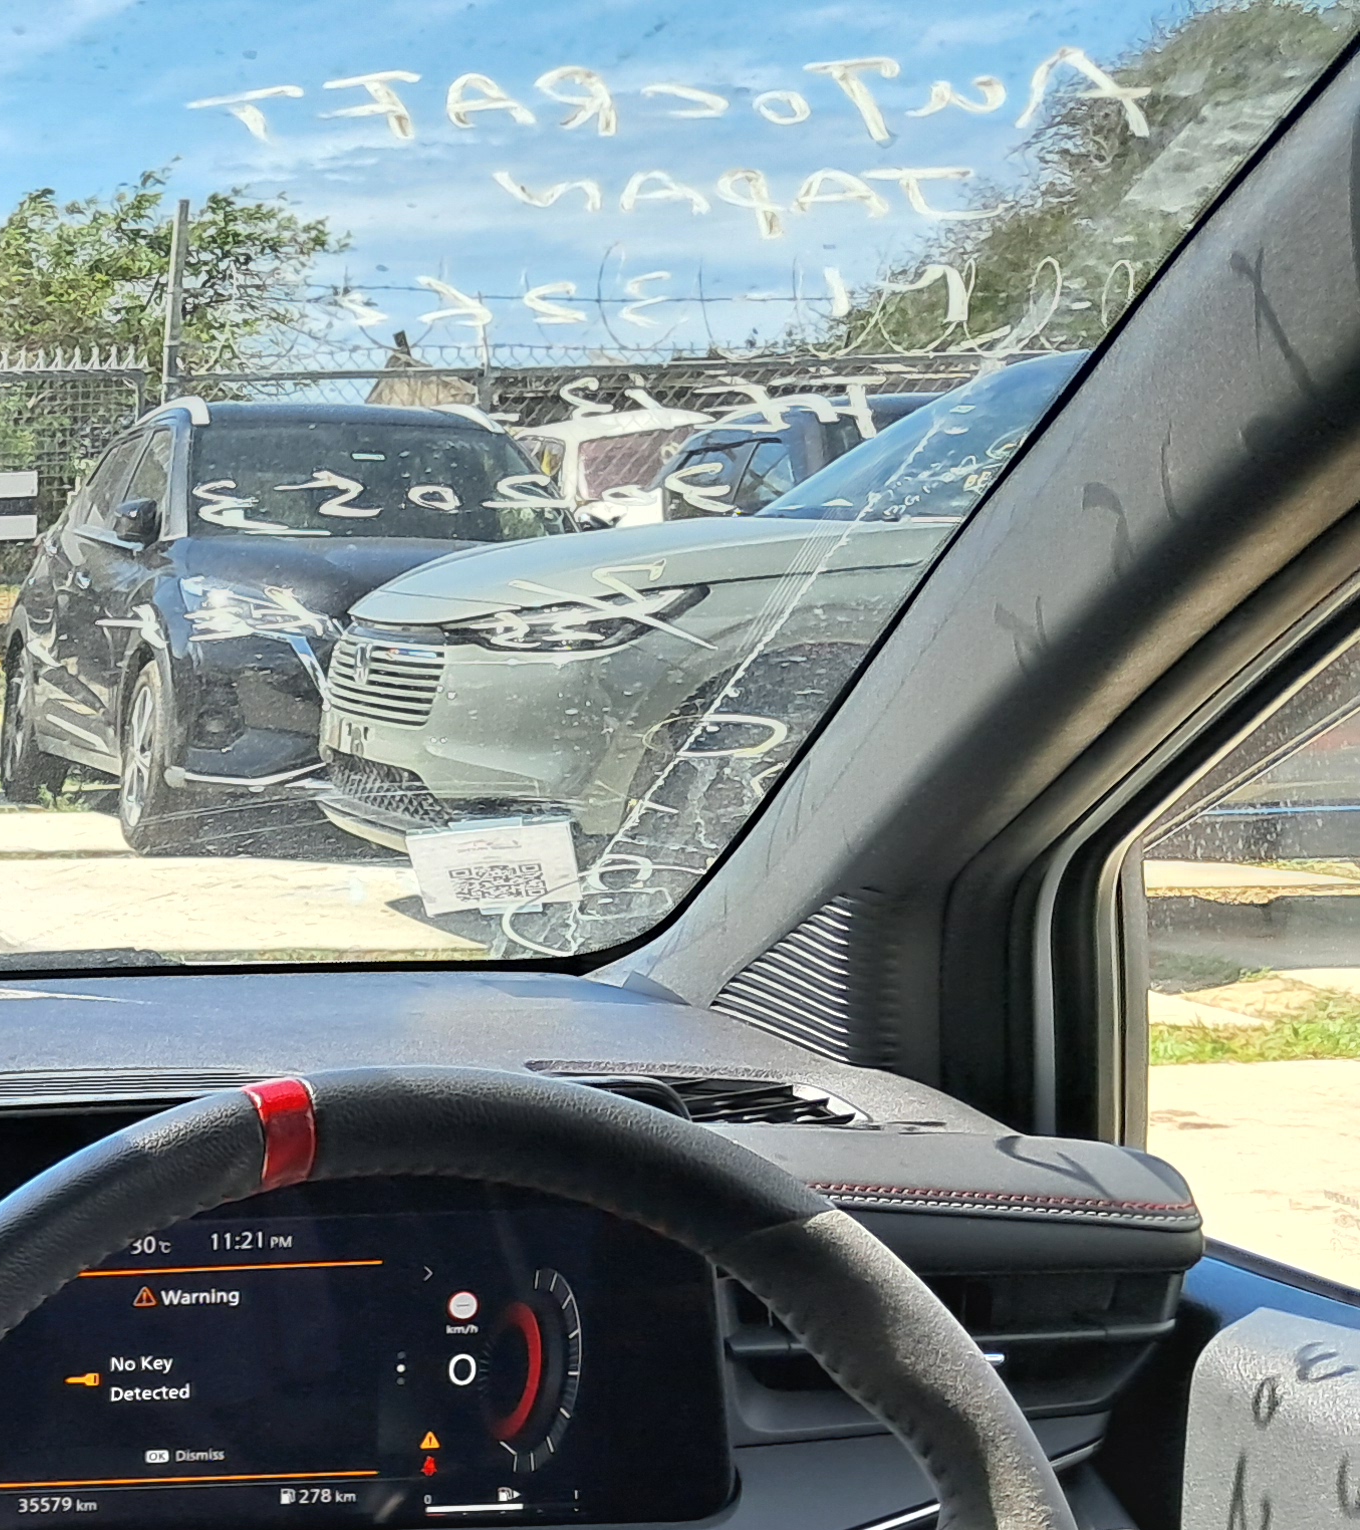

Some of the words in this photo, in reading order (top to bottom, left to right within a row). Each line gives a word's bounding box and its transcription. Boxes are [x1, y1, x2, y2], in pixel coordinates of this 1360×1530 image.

[211, 1231, 263, 1250] 11:21
[270, 1235, 293, 1248] PM
[160, 1288, 240, 1307] Warning
[446, 1324, 479, 1335] km/h
[110, 1357, 136, 1371] No
[141, 1356, 173, 1374] Key
[448, 1353, 477, 1387] 0
[110, 1383, 191, 1402] Detected
[148, 1450, 168, 1462] OK
[175, 1448, 225, 1463] Dismiss
[17, 1496, 72, 1515] 35579
[76, 1498, 98, 1513] km
[298, 1488, 332, 1505] 278
[335, 1489, 356, 1504] km
